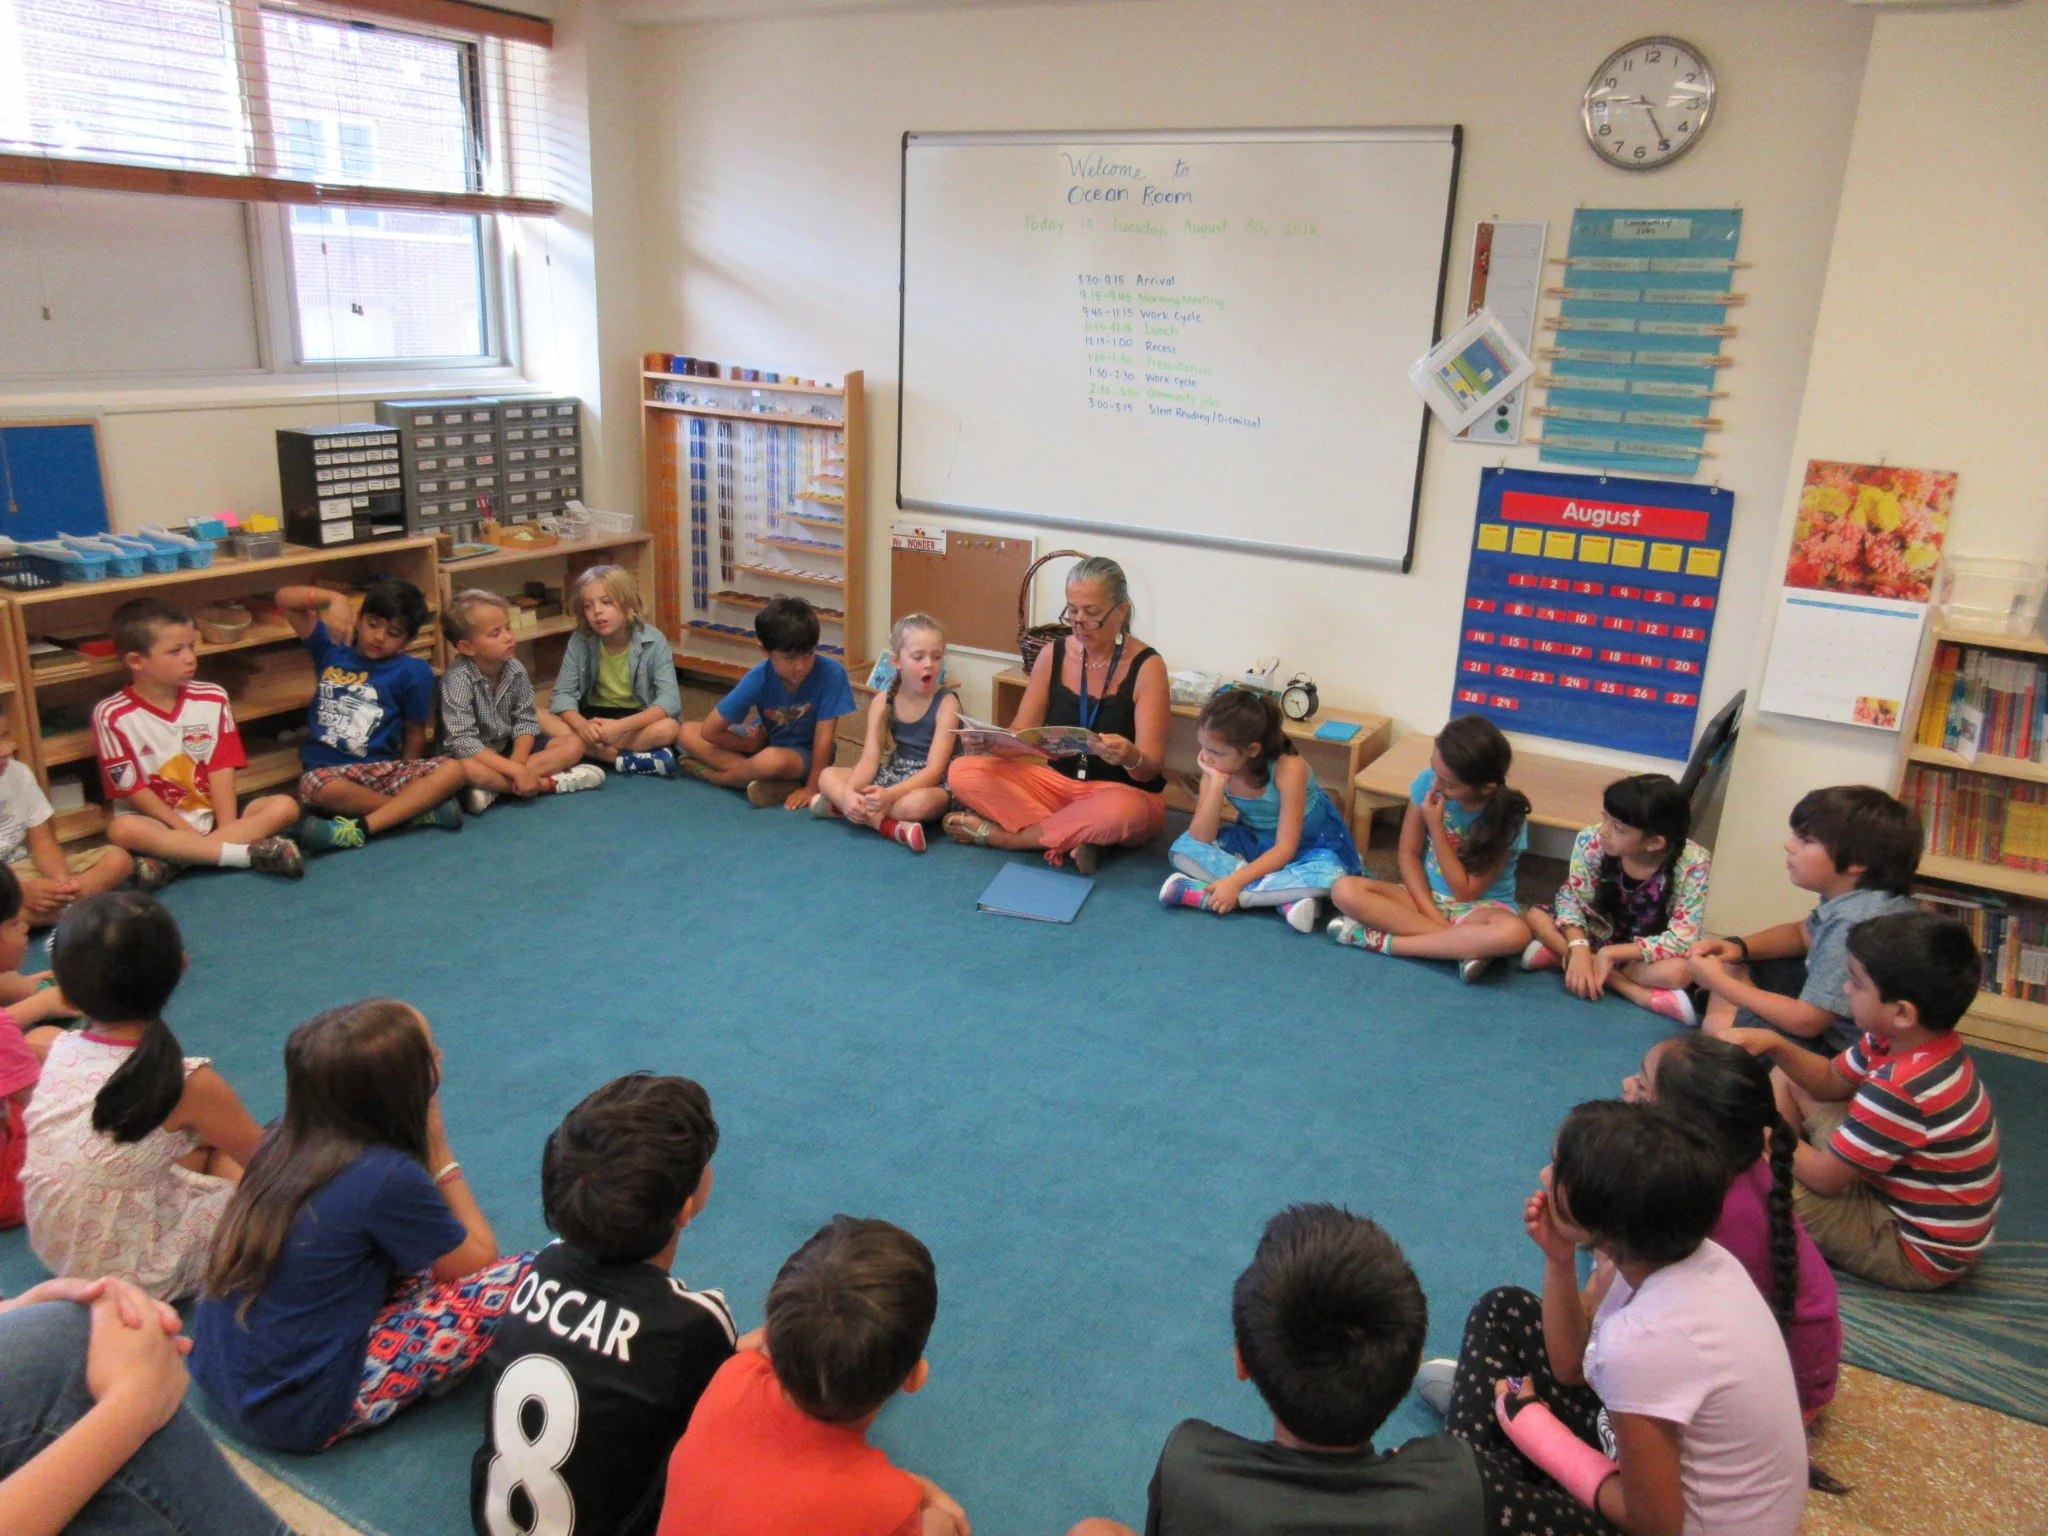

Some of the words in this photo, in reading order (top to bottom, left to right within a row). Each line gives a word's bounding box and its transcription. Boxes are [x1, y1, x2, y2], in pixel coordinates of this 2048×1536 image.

[1646, 51, 1661, 63] 12
[1673, 55, 1679, 67] 1
[1624, 60, 1633, 71] 11
[1594, 101, 1607, 113] 9
[1599, 124, 1612, 136] 8
[1678, 120, 1688, 132] 4
[1614, 141, 1624, 153] 7
[1658, 139, 1670, 151] 5
[1634, 147, 1646, 159] 6
[1061, 152, 1147, 181] Welcome
[1172, 158, 1191, 179] to
[1067, 185, 1129, 205] Ocean
[1141, 185, 1193, 206] Room
[1022, 214, 1065, 233] Today
[1080, 217, 1093, 228] is
[1184, 217, 1229, 236] August
[1624, 218, 1674, 229] Community
[1136, 274, 1175, 286] Arrival
[1140, 309, 1169, 320] Work
[1174, 311, 1202, 326] Cycle
[1145, 322, 1178, 336] Lunch
[1145, 340, 1177, 353] Recess
[1147, 356, 1212, 376] Presentation
[1146, 373, 1170, 385] Work
[1148, 404, 1172, 417] Silent
[1562, 501, 1642, 528] August
[892, 537, 902, 547] We
[907, 538, 935, 551] WONDER
[1519, 576, 1524, 585] 1
[1550, 579, 1558, 589] 2
[1584, 583, 1591, 593] 3
[1620, 588, 1628, 598] 4
[1654, 592, 1662, 602] 5
[1693, 597, 1701, 607] 6
[1476, 600, 1484, 610] 7
[1514, 606, 1522, 615] 8
[1547, 610, 1554, 620] 9
[1575, 614, 1588, 624] 10
[1613, 619, 1623, 628] 11
[1646, 624, 1658, 634] 12
[1682, 628, 1694, 638] 13
[1474, 632, 1486, 642] 14
[1509, 637, 1520, 647] 15
[1541, 641, 1552, 652] 16
[1572, 646, 1583, 657] 17
[1609, 651, 1621, 662] 18
[1640, 655, 1652, 666] 19
[1675, 661, 1690, 672] 20
[1470, 662, 1482, 672] 21
[1501, 667, 1516, 677] 22
[1531, 671, 1545, 682] 23
[1566, 677, 1581, 688] 24
[1601, 682, 1615, 693] 25
[1633, 688, 1648, 699] 26
[1672, 693, 1687, 705] 27
[1464, 692, 1478, 702] 28
[1496, 697, 1511, 708] 29
[510, 1271, 640, 1362] OSCAR
[485, 1353, 580, 1536] 8
